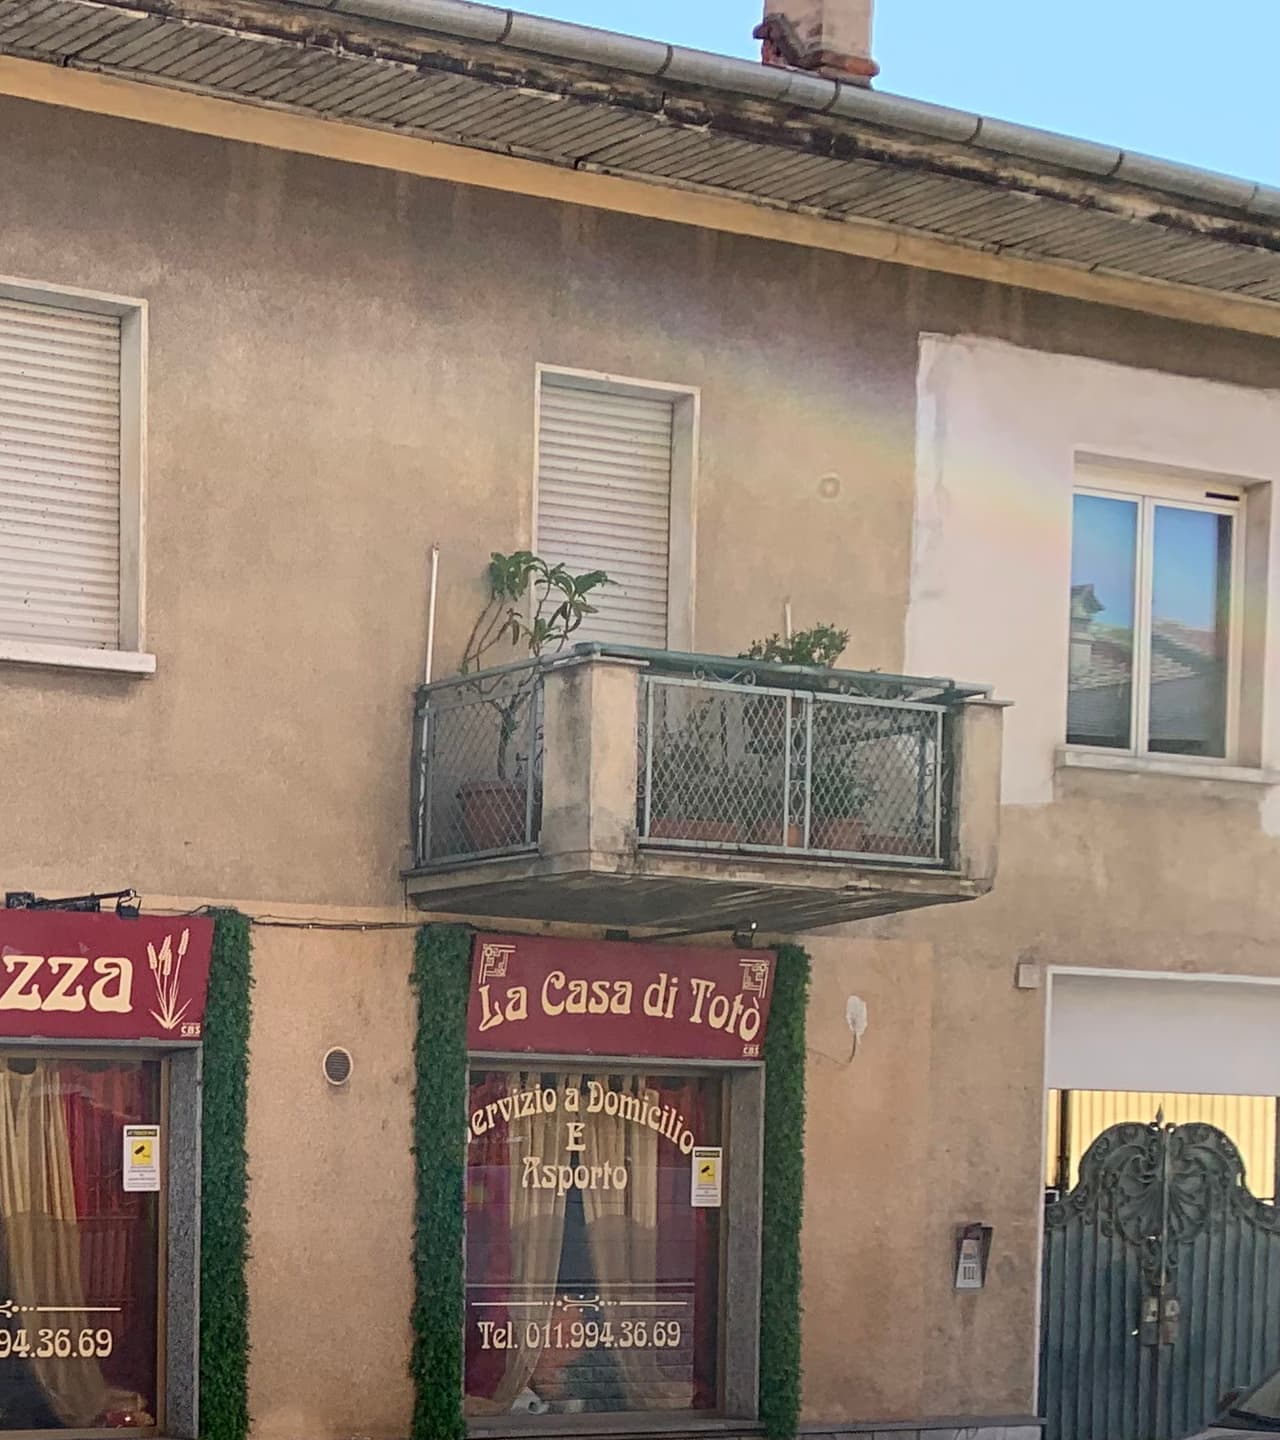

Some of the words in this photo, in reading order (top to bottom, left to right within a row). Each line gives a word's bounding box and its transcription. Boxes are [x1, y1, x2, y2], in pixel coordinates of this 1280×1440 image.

[478, 984, 528, 1032] La
[541, 970, 633, 1016] Casa
[643, 973, 678, 1019] di
[689, 978, 761, 1042] Totò
[467, 1083, 557, 1143] ervizio
[564, 1087, 580, 1112] a
[587, 1081, 695, 1154] Domicilio
[566, 1122, 587, 1151] E
[522, 1156, 628, 1196] Asporto
[477, 1321, 518, 1349] Tel.
[526, 1321, 681, 1348] 011.994.36.69
